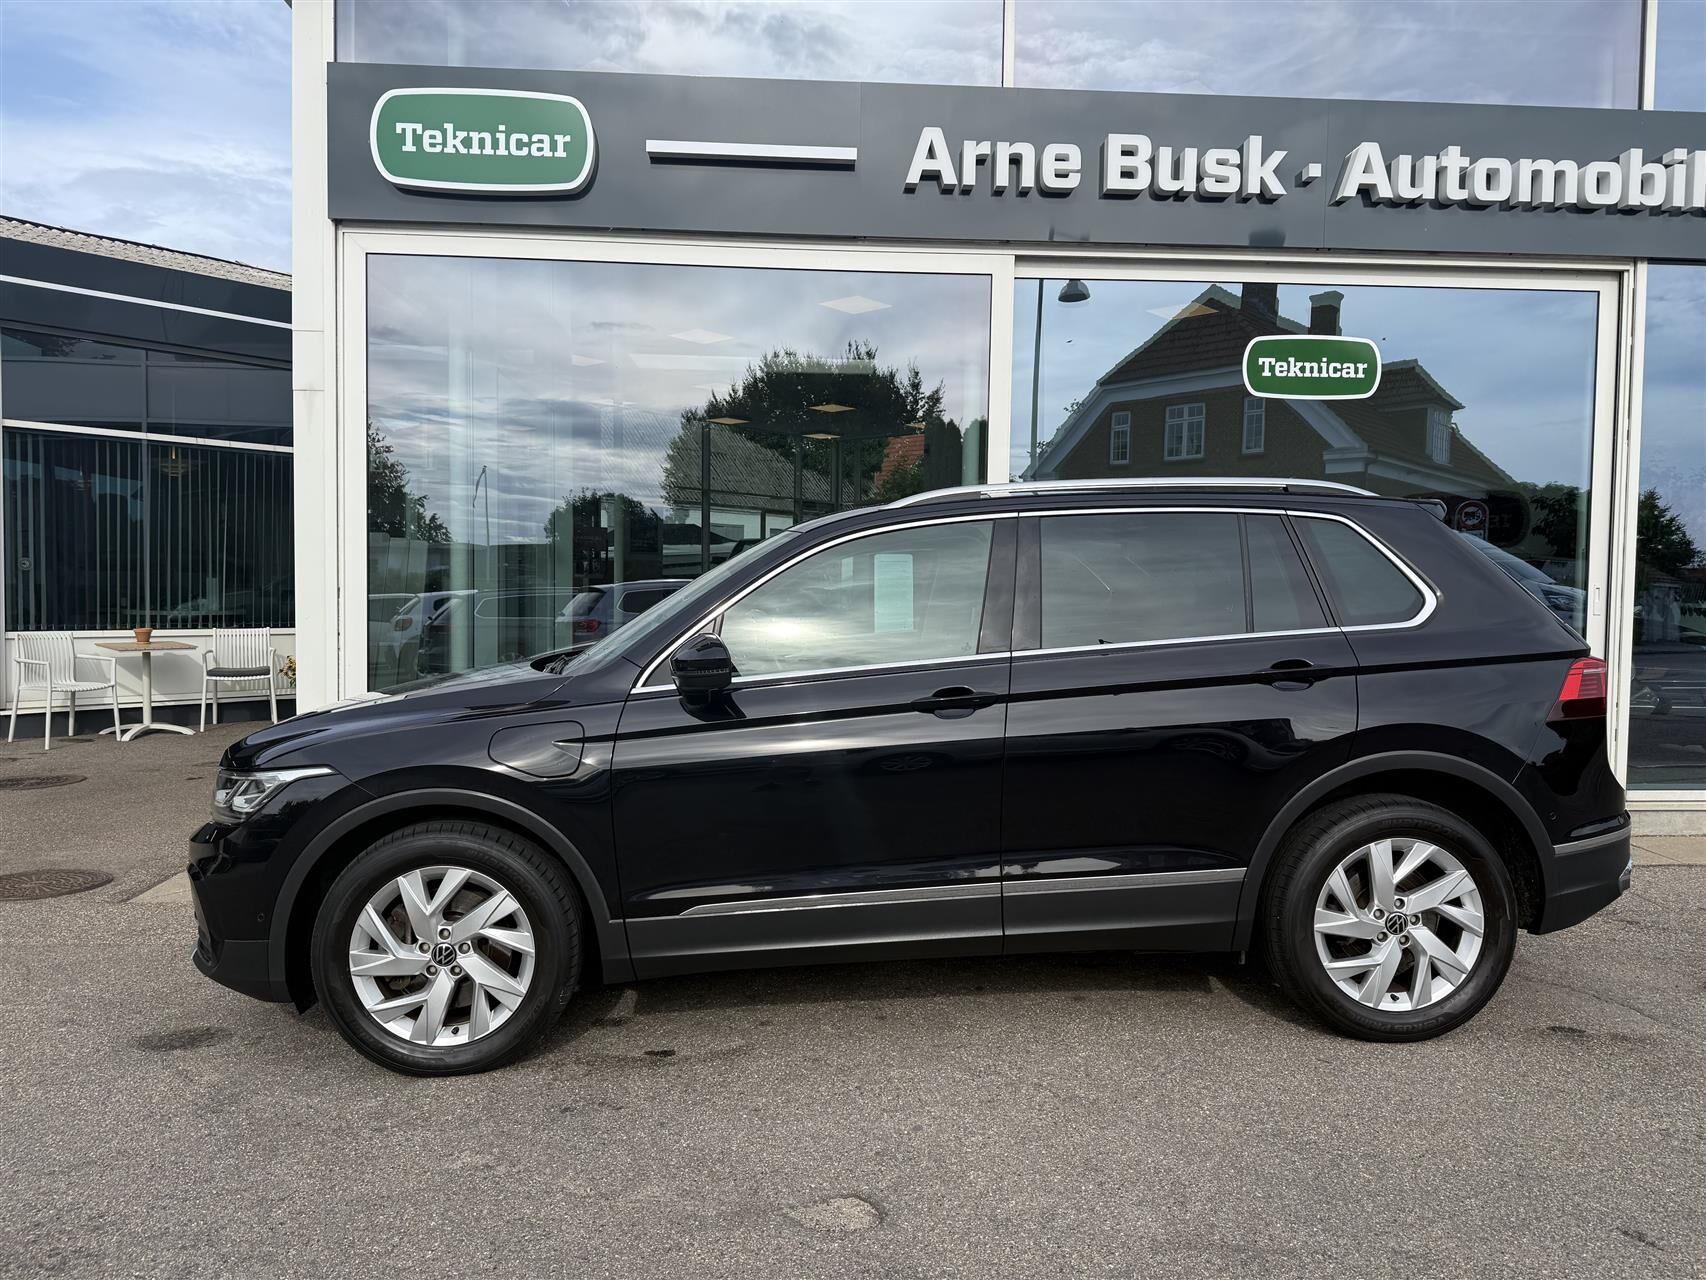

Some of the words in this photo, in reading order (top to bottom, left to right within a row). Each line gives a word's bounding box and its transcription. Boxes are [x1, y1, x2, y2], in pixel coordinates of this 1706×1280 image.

[395, 122, 571, 158] Teknicar
[904, 126, 1082, 195] Arne
[1102, 133, 1288, 200] Busk
[1334, 141, 1706, 211] Automobil
[1258, 357, 1368, 378] Teknicar
